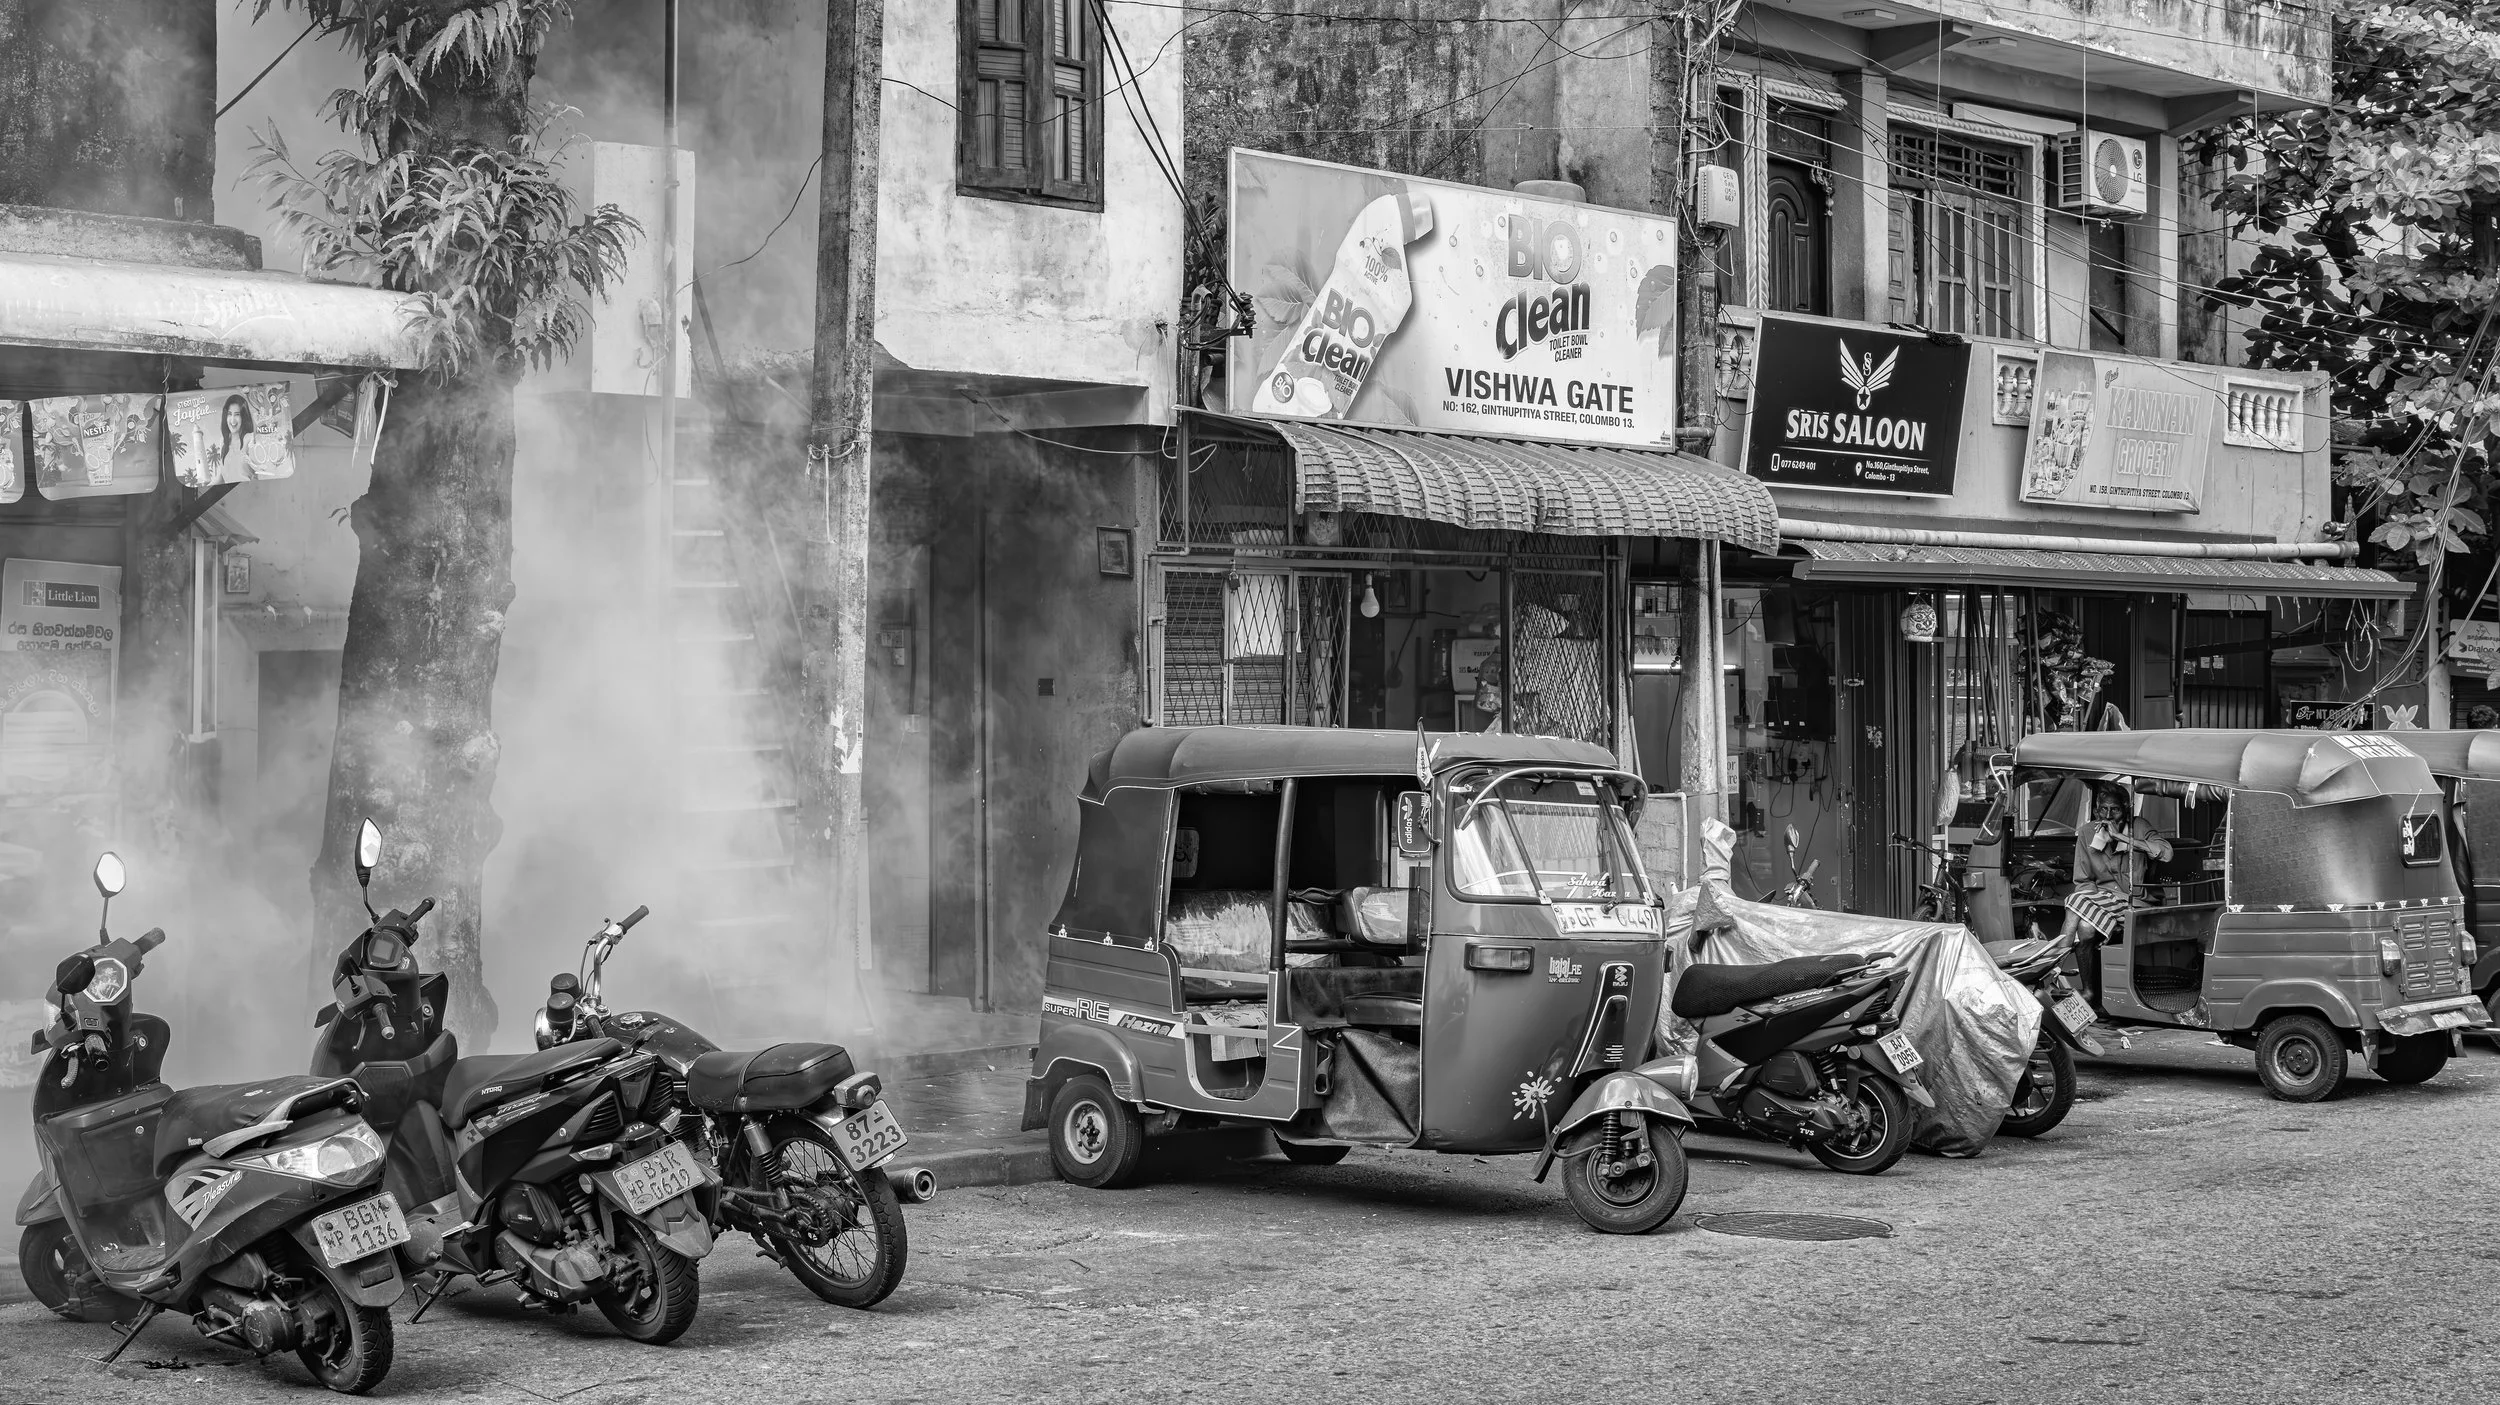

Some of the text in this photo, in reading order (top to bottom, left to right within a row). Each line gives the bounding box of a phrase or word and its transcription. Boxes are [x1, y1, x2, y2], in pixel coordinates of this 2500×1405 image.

[1508, 213, 1582, 284] BIO
[1363, 271, 1378, 286] ACTIVE
[1364, 254, 1388, 283] 100%
[1321, 287, 1376, 349] BIO
[1496, 282, 1591, 361] Clean
[1301, 328, 1372, 384] Clean
[1549, 334, 1588, 352] TOILET BOWL
[1554, 347, 1583, 363] CLEANER
[1275, 375, 1292, 397] BIO
[1334, 374, 1350, 388] TOILET
[1444, 367, 1634, 414] VISHWA GATE
[1442, 400, 1635, 429] NO: 162, GINTHUPITIYA STREET, COLOMBO 13.
[2105, 386, 2200, 436] KANNAN
[83, 424, 112, 437] NESTEA
[256, 426, 278, 434] NESTEA
[1786, 409, 1927, 451] SRIS SALOON
[1780, 459, 1816, 471] 077 6249 401
[2116, 438, 2179, 477] GROCERY
[1864, 471, 1886, 481] Colombo
[1889, 474, 1895, 482] 13
[48, 589, 97, 603] Little Lion
[1405, 817, 1413, 844] adidas
[1574, 907, 1597, 928] GF
[1044, 997, 1171, 1036] SUPER RE Hazna
[1890, 1035, 1906, 1050] BJT
[1896, 1047, 1918, 1067] 0956
[845, 1114, 870, 1140] 87
[1799, 1127, 1815, 1136] TVS
[850, 1125, 901, 1164] 3223
[202, 1170, 241, 1211] Pleasure
[341, 1198, 390, 1232] BGM
[323, 1221, 399, 1256] WP 1136
[543, 1287, 560, 1299] TVS
